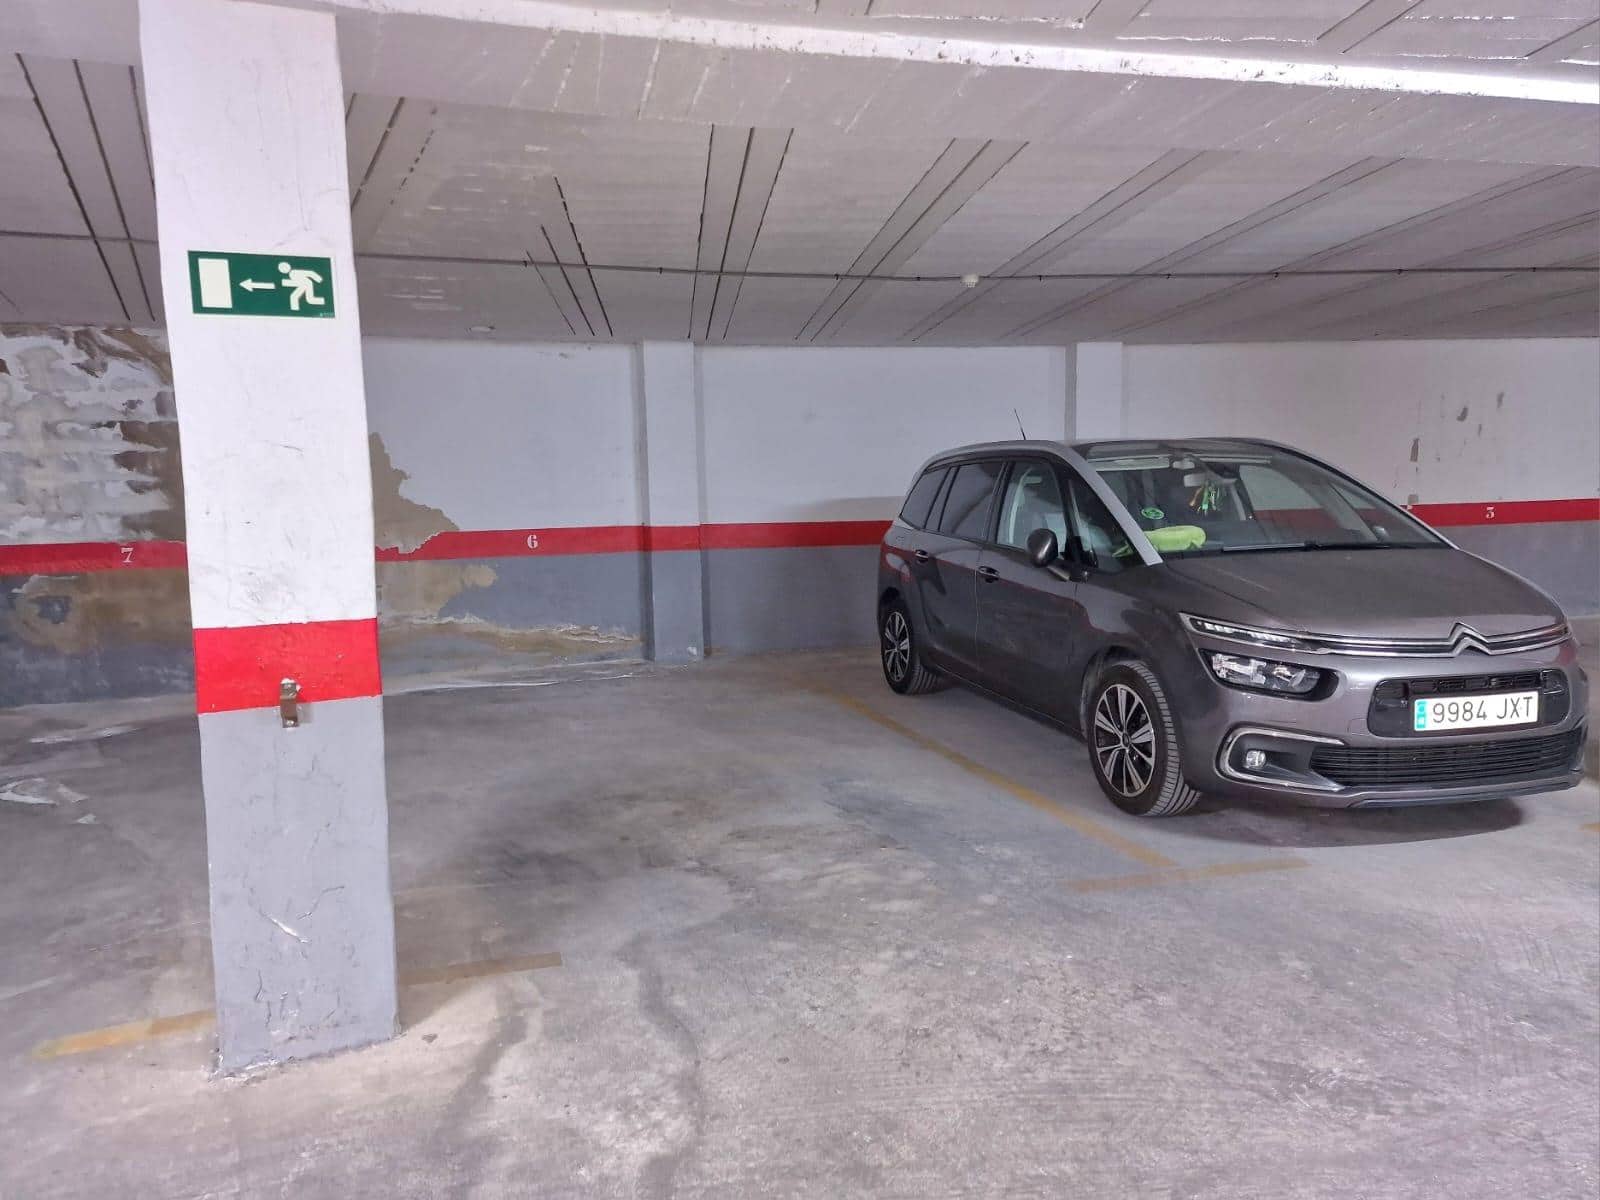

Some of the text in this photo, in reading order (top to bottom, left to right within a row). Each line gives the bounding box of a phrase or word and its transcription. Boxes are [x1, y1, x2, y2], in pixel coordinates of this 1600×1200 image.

[527, 534, 538, 549] 6
[121, 547, 134, 563] 7
[1432, 700, 1487, 723] 9984
[1496, 696, 1533, 719] JXT
